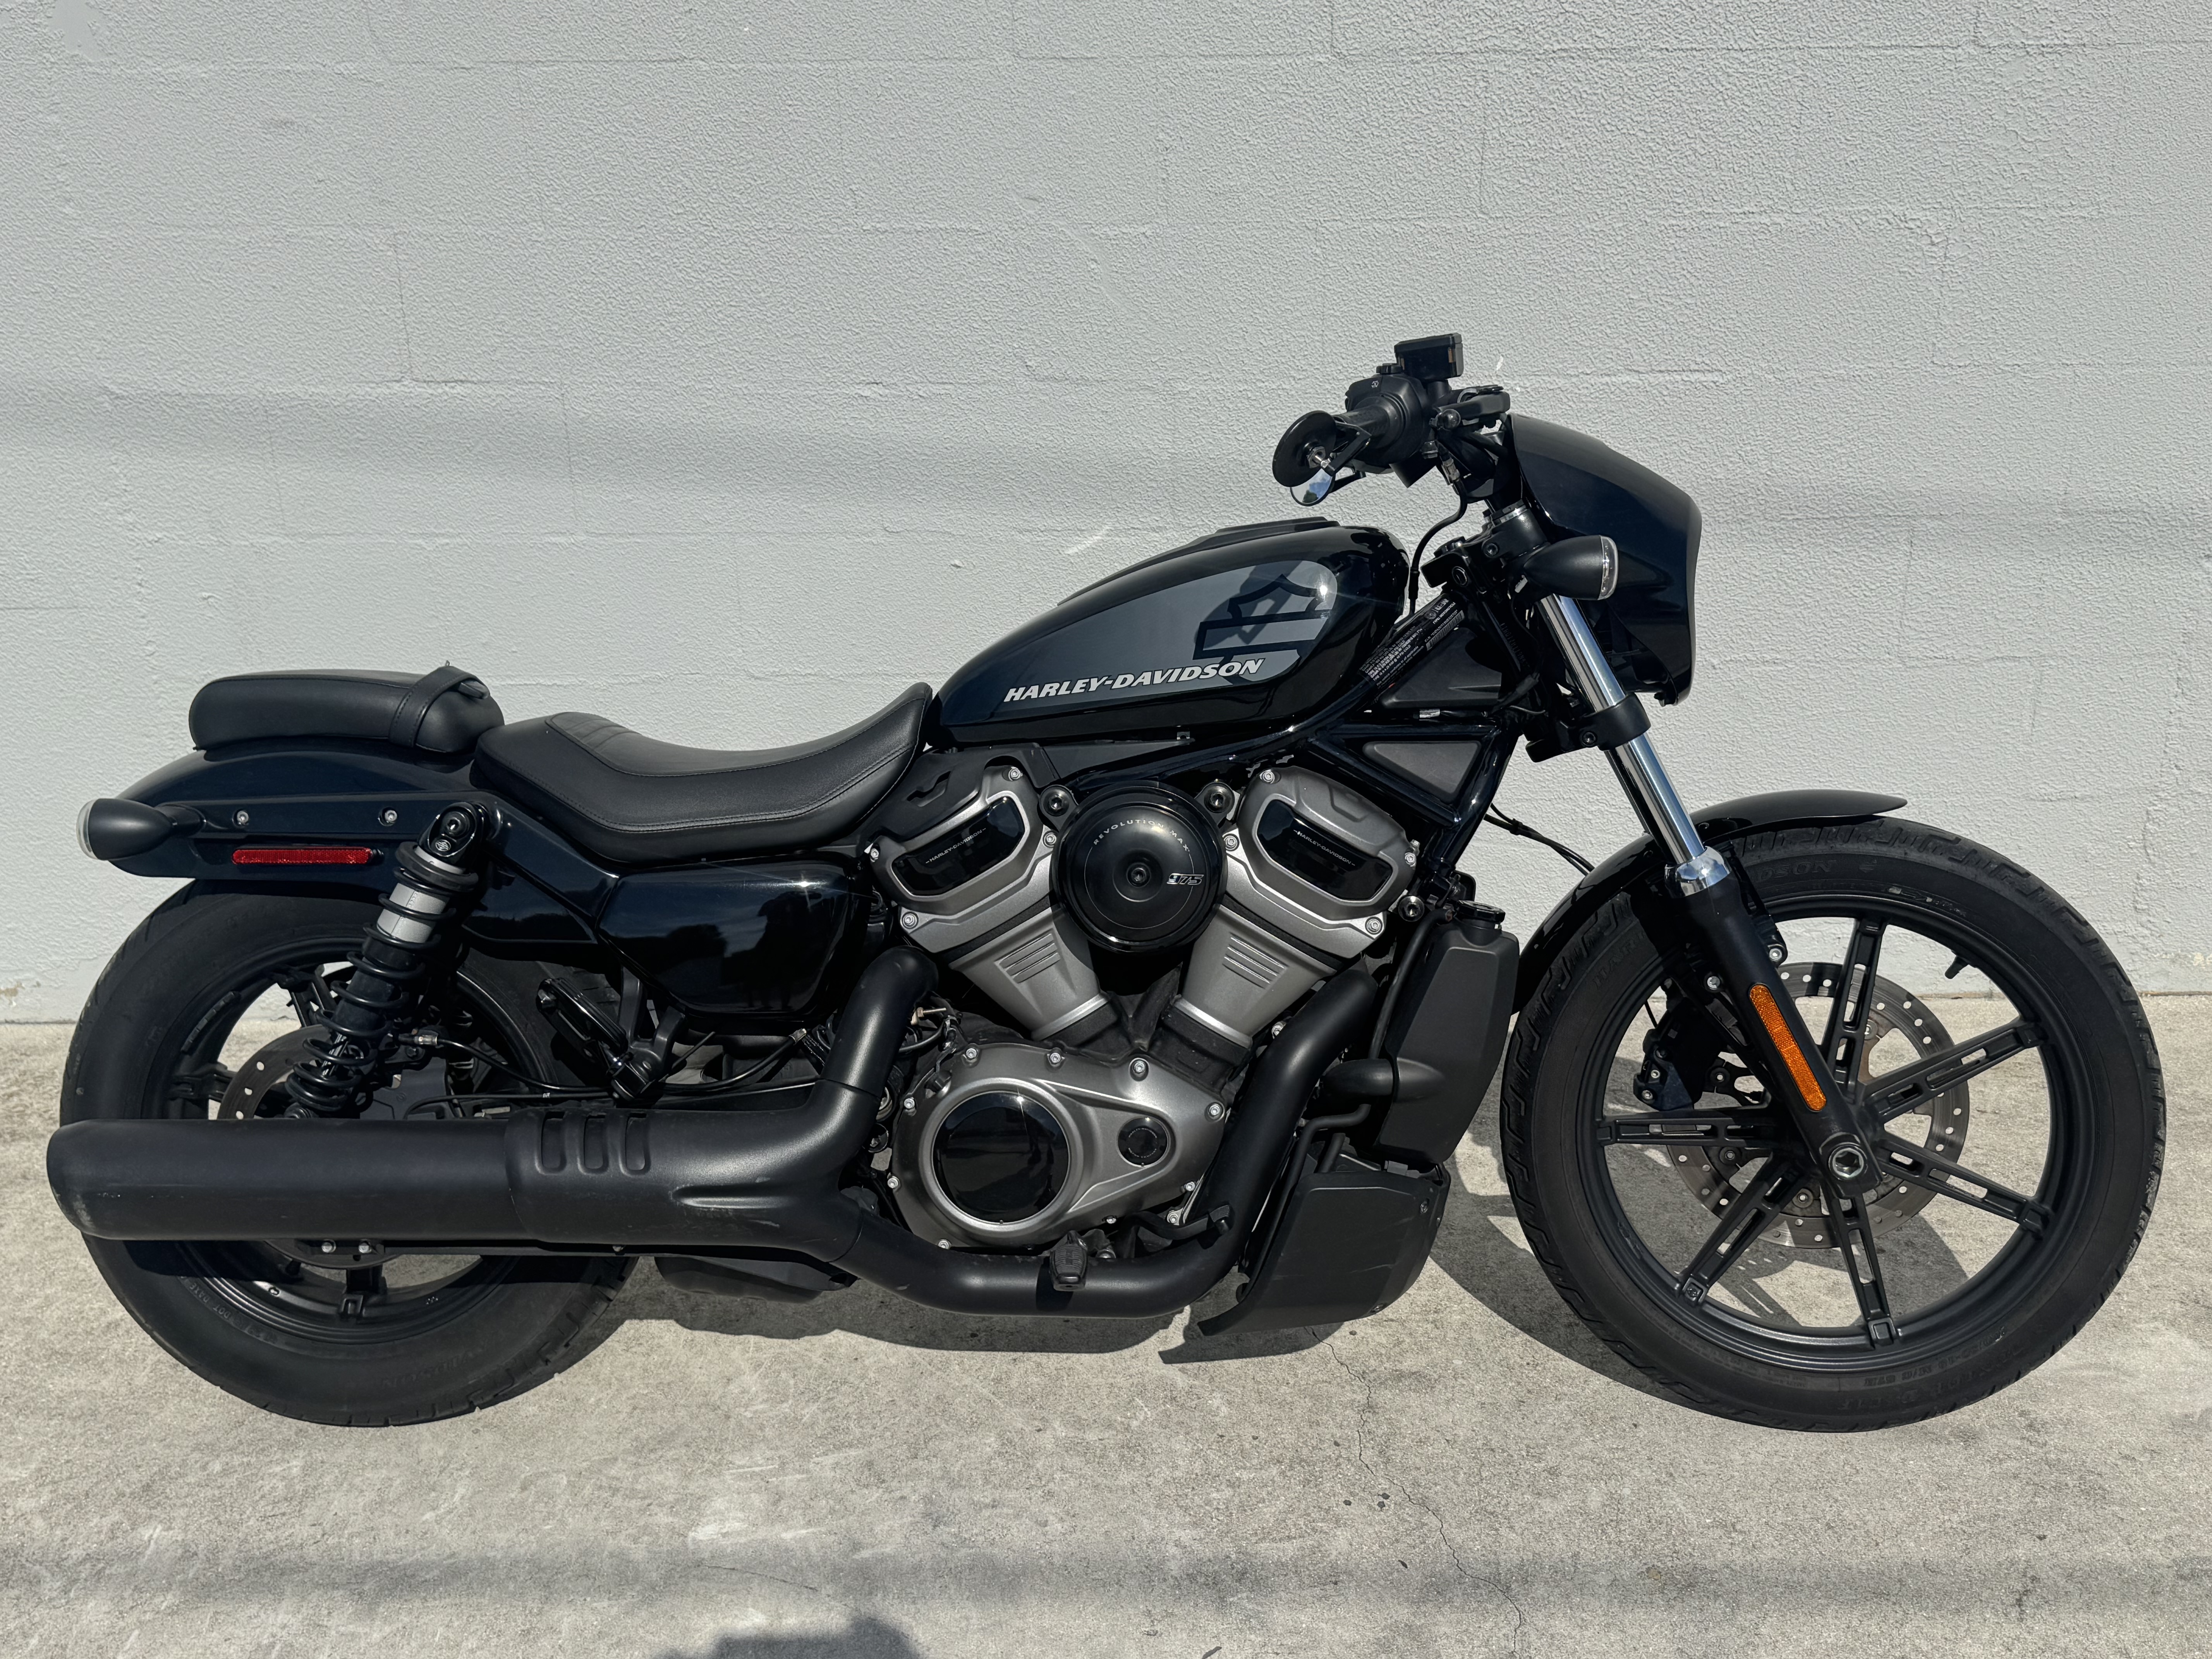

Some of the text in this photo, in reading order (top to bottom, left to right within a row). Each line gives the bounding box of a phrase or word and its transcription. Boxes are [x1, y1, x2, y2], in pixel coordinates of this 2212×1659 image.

[1003, 658, 1266, 702] HARLEY-DAVIDSON
[928, 829, 983, 863] HARLEY-DAVIDSON
[1093, 819, 1164, 845] REVOLUTION
[1170, 830, 1189, 851] MAX
[1296, 830, 1352, 865] HARLEY-DAVIDSON
[1166, 873, 1204, 885] 975
